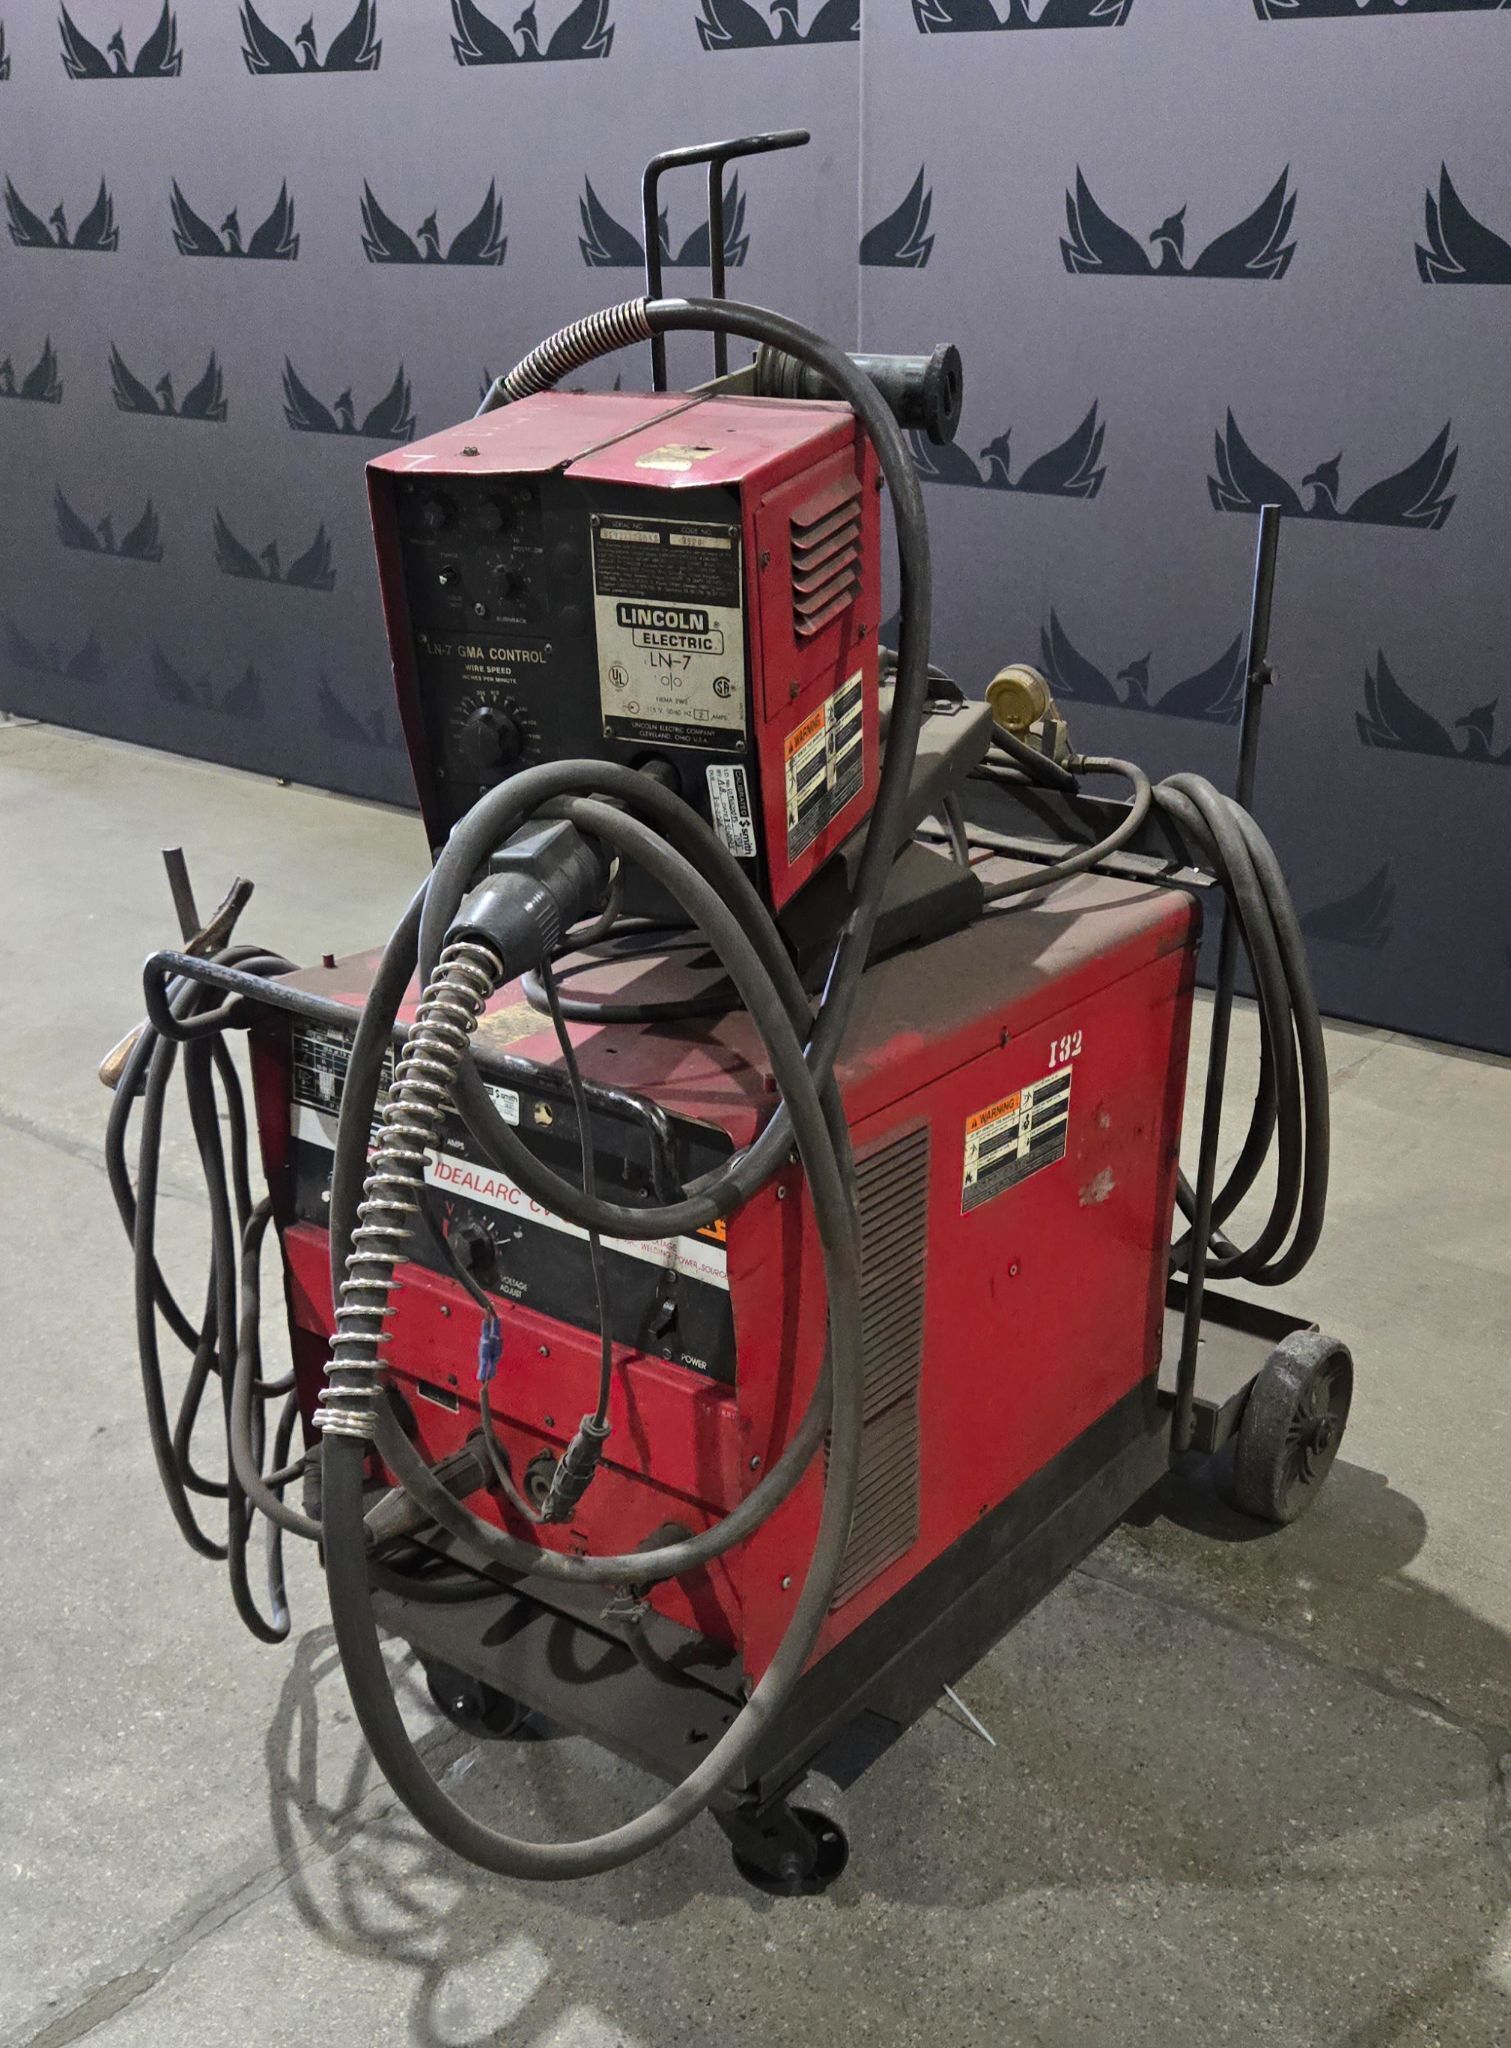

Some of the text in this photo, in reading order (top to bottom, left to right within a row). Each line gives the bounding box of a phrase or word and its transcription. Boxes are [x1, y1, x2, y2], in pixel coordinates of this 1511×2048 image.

[620, 606, 704, 631] LINCOLN
[426, 642, 547, 664] LN-7 GMA CONTROL
[643, 632, 713, 650] ELECTRIC
[464, 663, 512, 675] WIRE SPEED
[649, 651, 692, 671] LN-7
[793, 713, 821, 749] WARNING
[734, 770, 748, 817] CALIBRATED
[741, 828, 753, 855] smith
[979, 1098, 1015, 1123] WARNING
[433, 1159, 522, 1205] IDEALARC
[640, 1243, 672, 1259] WELDING
[675, 1254, 698, 1269] POWER
[500, 1273, 528, 1292] VOLTAGE
[680, 1352, 708, 1370] POWER
